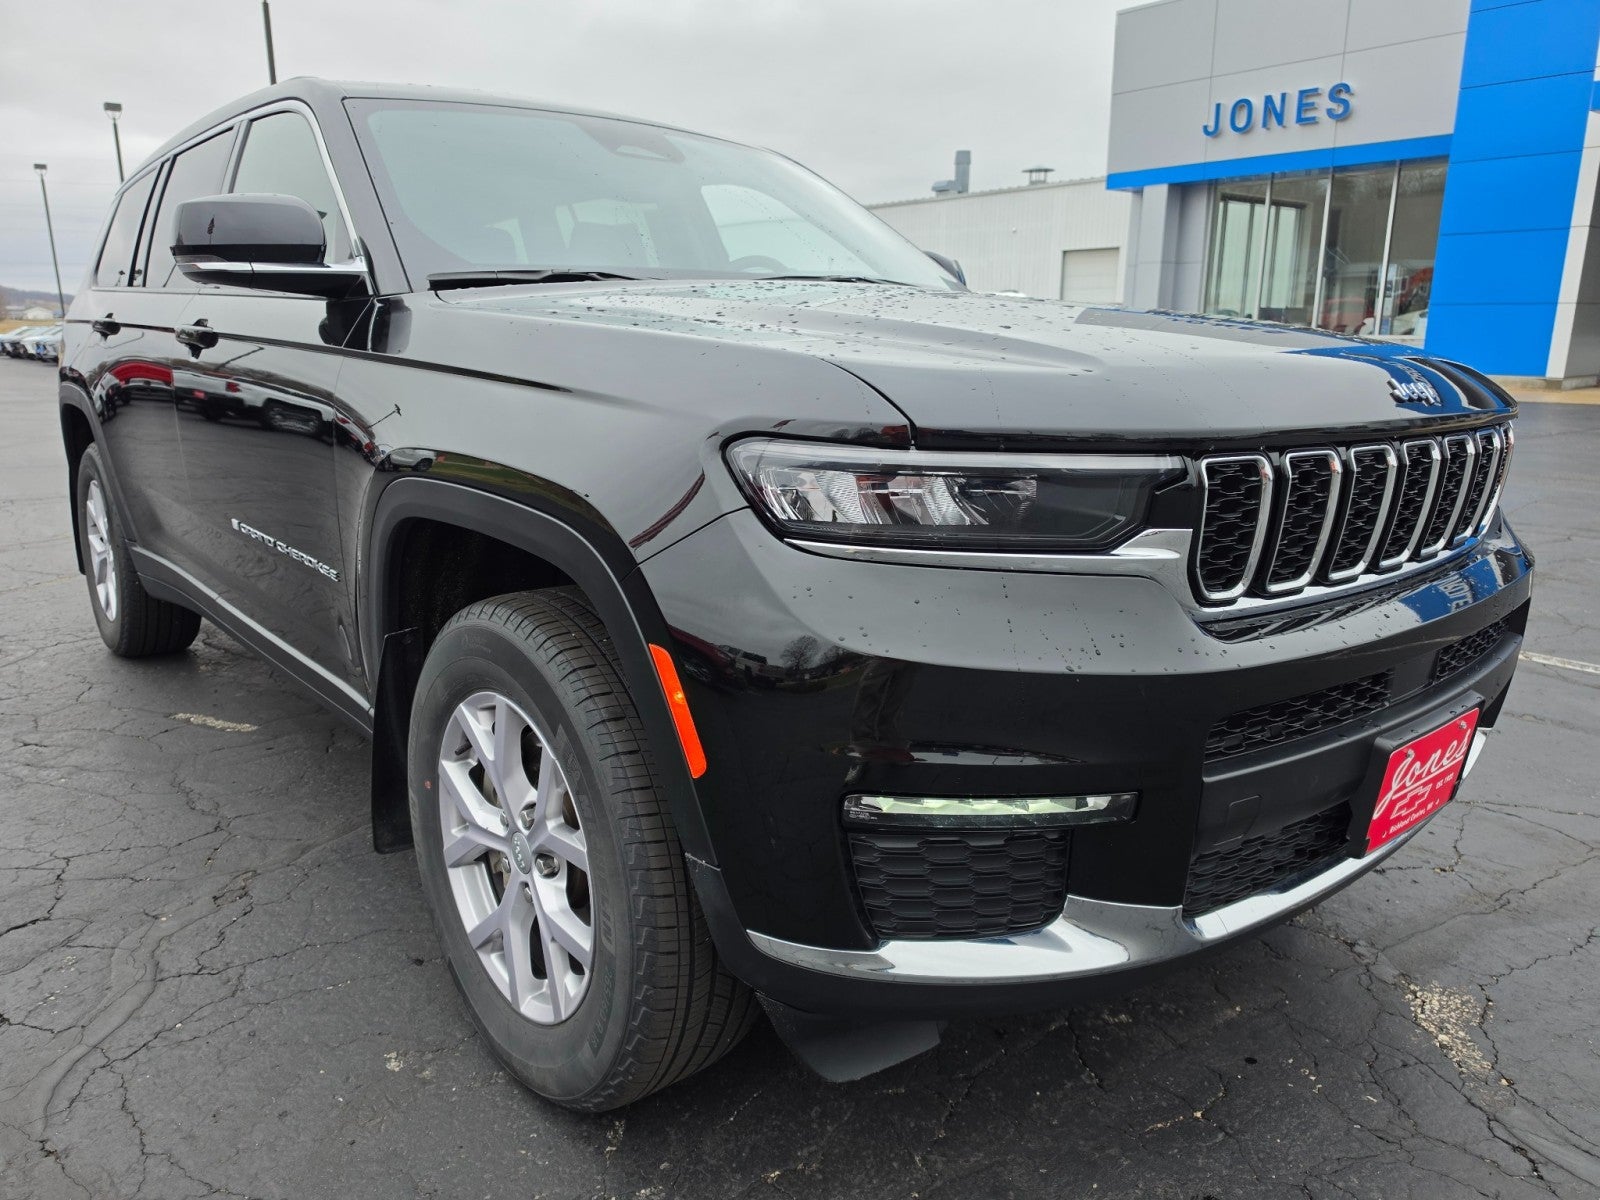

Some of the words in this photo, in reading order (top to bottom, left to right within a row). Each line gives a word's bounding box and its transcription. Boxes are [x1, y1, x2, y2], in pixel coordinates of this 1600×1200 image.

[1202, 82, 1353, 138] JONES
[1389, 378, 1436, 405] Jeep
[239, 523, 276, 548] GRAND
[276, 541, 339, 582] CHEROKEE
[1373, 729, 1472, 820] Jones
